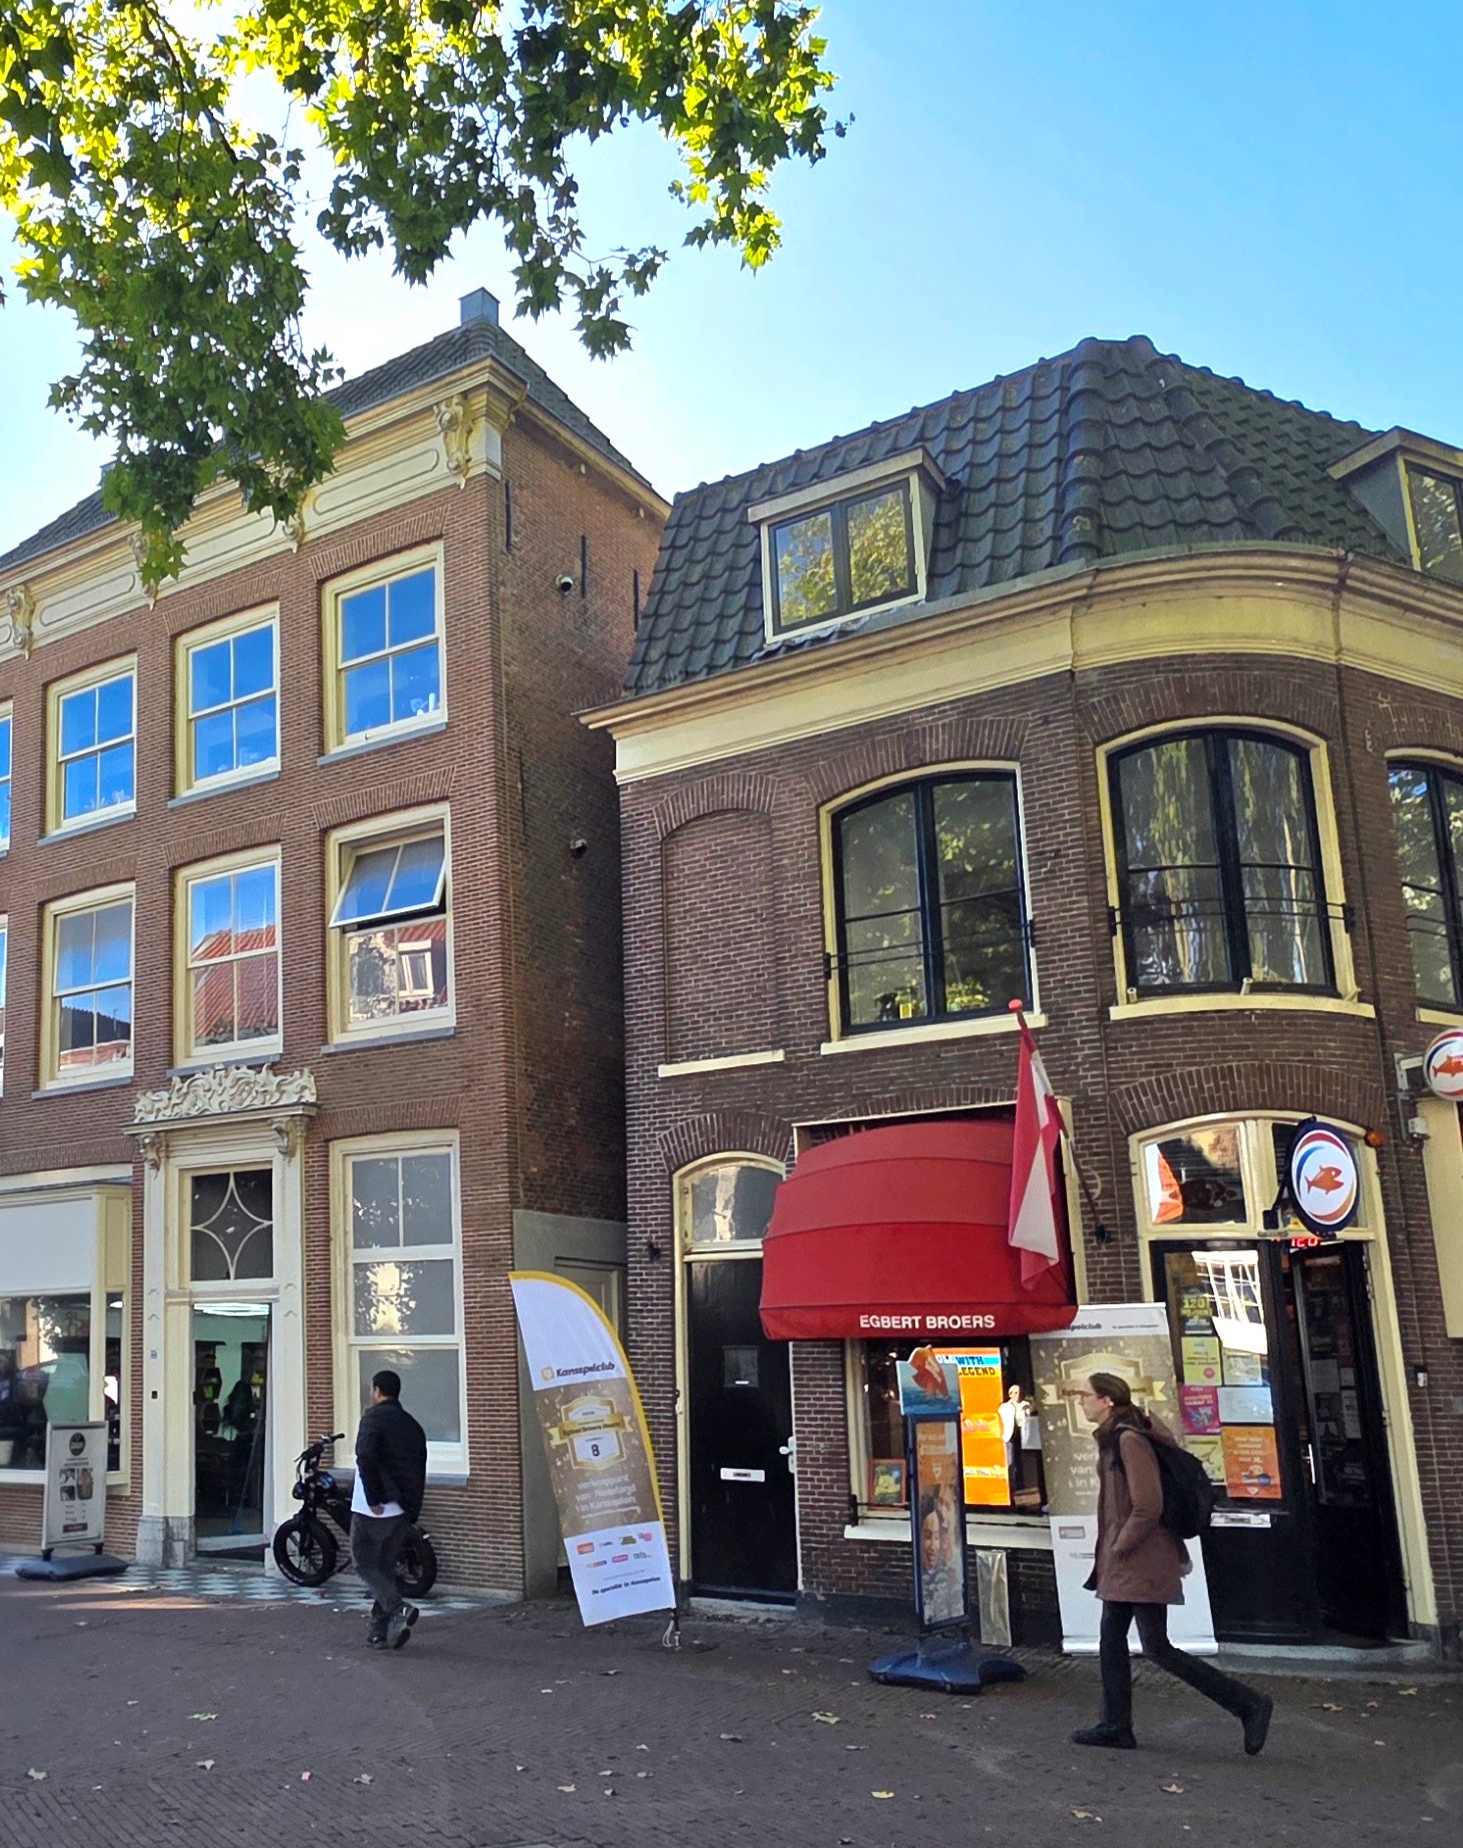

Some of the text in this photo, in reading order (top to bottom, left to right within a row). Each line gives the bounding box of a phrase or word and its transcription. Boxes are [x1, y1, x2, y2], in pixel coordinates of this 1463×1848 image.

[859, 1315, 995, 1329] EGBERT BROERS
[1070, 1323, 1102, 1332] pelclub
[956, 1356, 985, 1365] WITH
[556, 1361, 615, 1377] Kansspelclub
[959, 1367, 996, 1376] EGEND
[591, 1444, 600, 1457] 8
